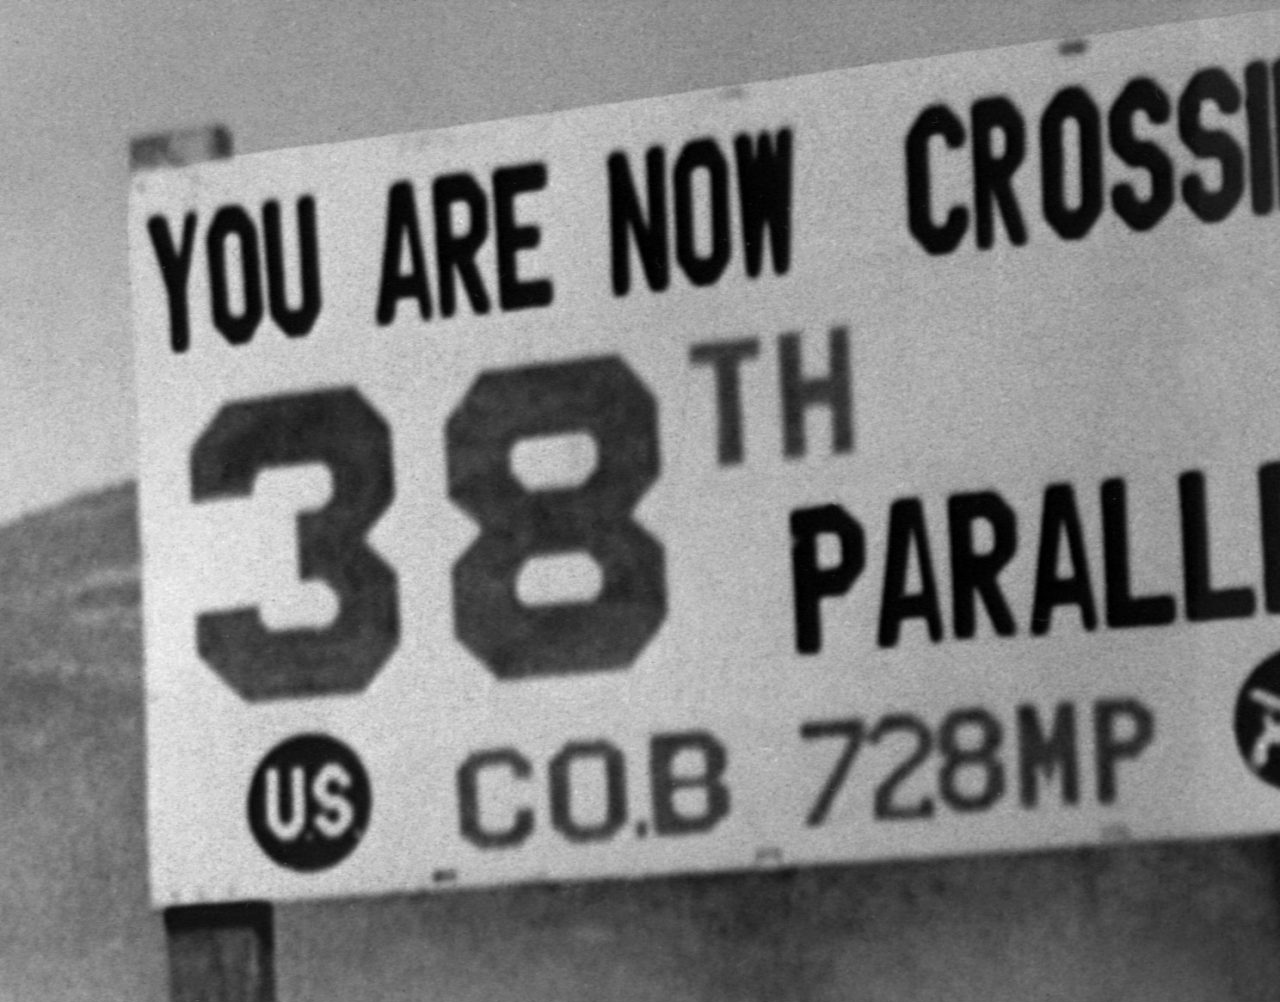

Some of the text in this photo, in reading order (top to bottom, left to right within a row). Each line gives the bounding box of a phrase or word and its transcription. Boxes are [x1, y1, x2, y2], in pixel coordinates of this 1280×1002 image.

[147, 57, 1280, 353] YOU ARE NOW CROSSI
